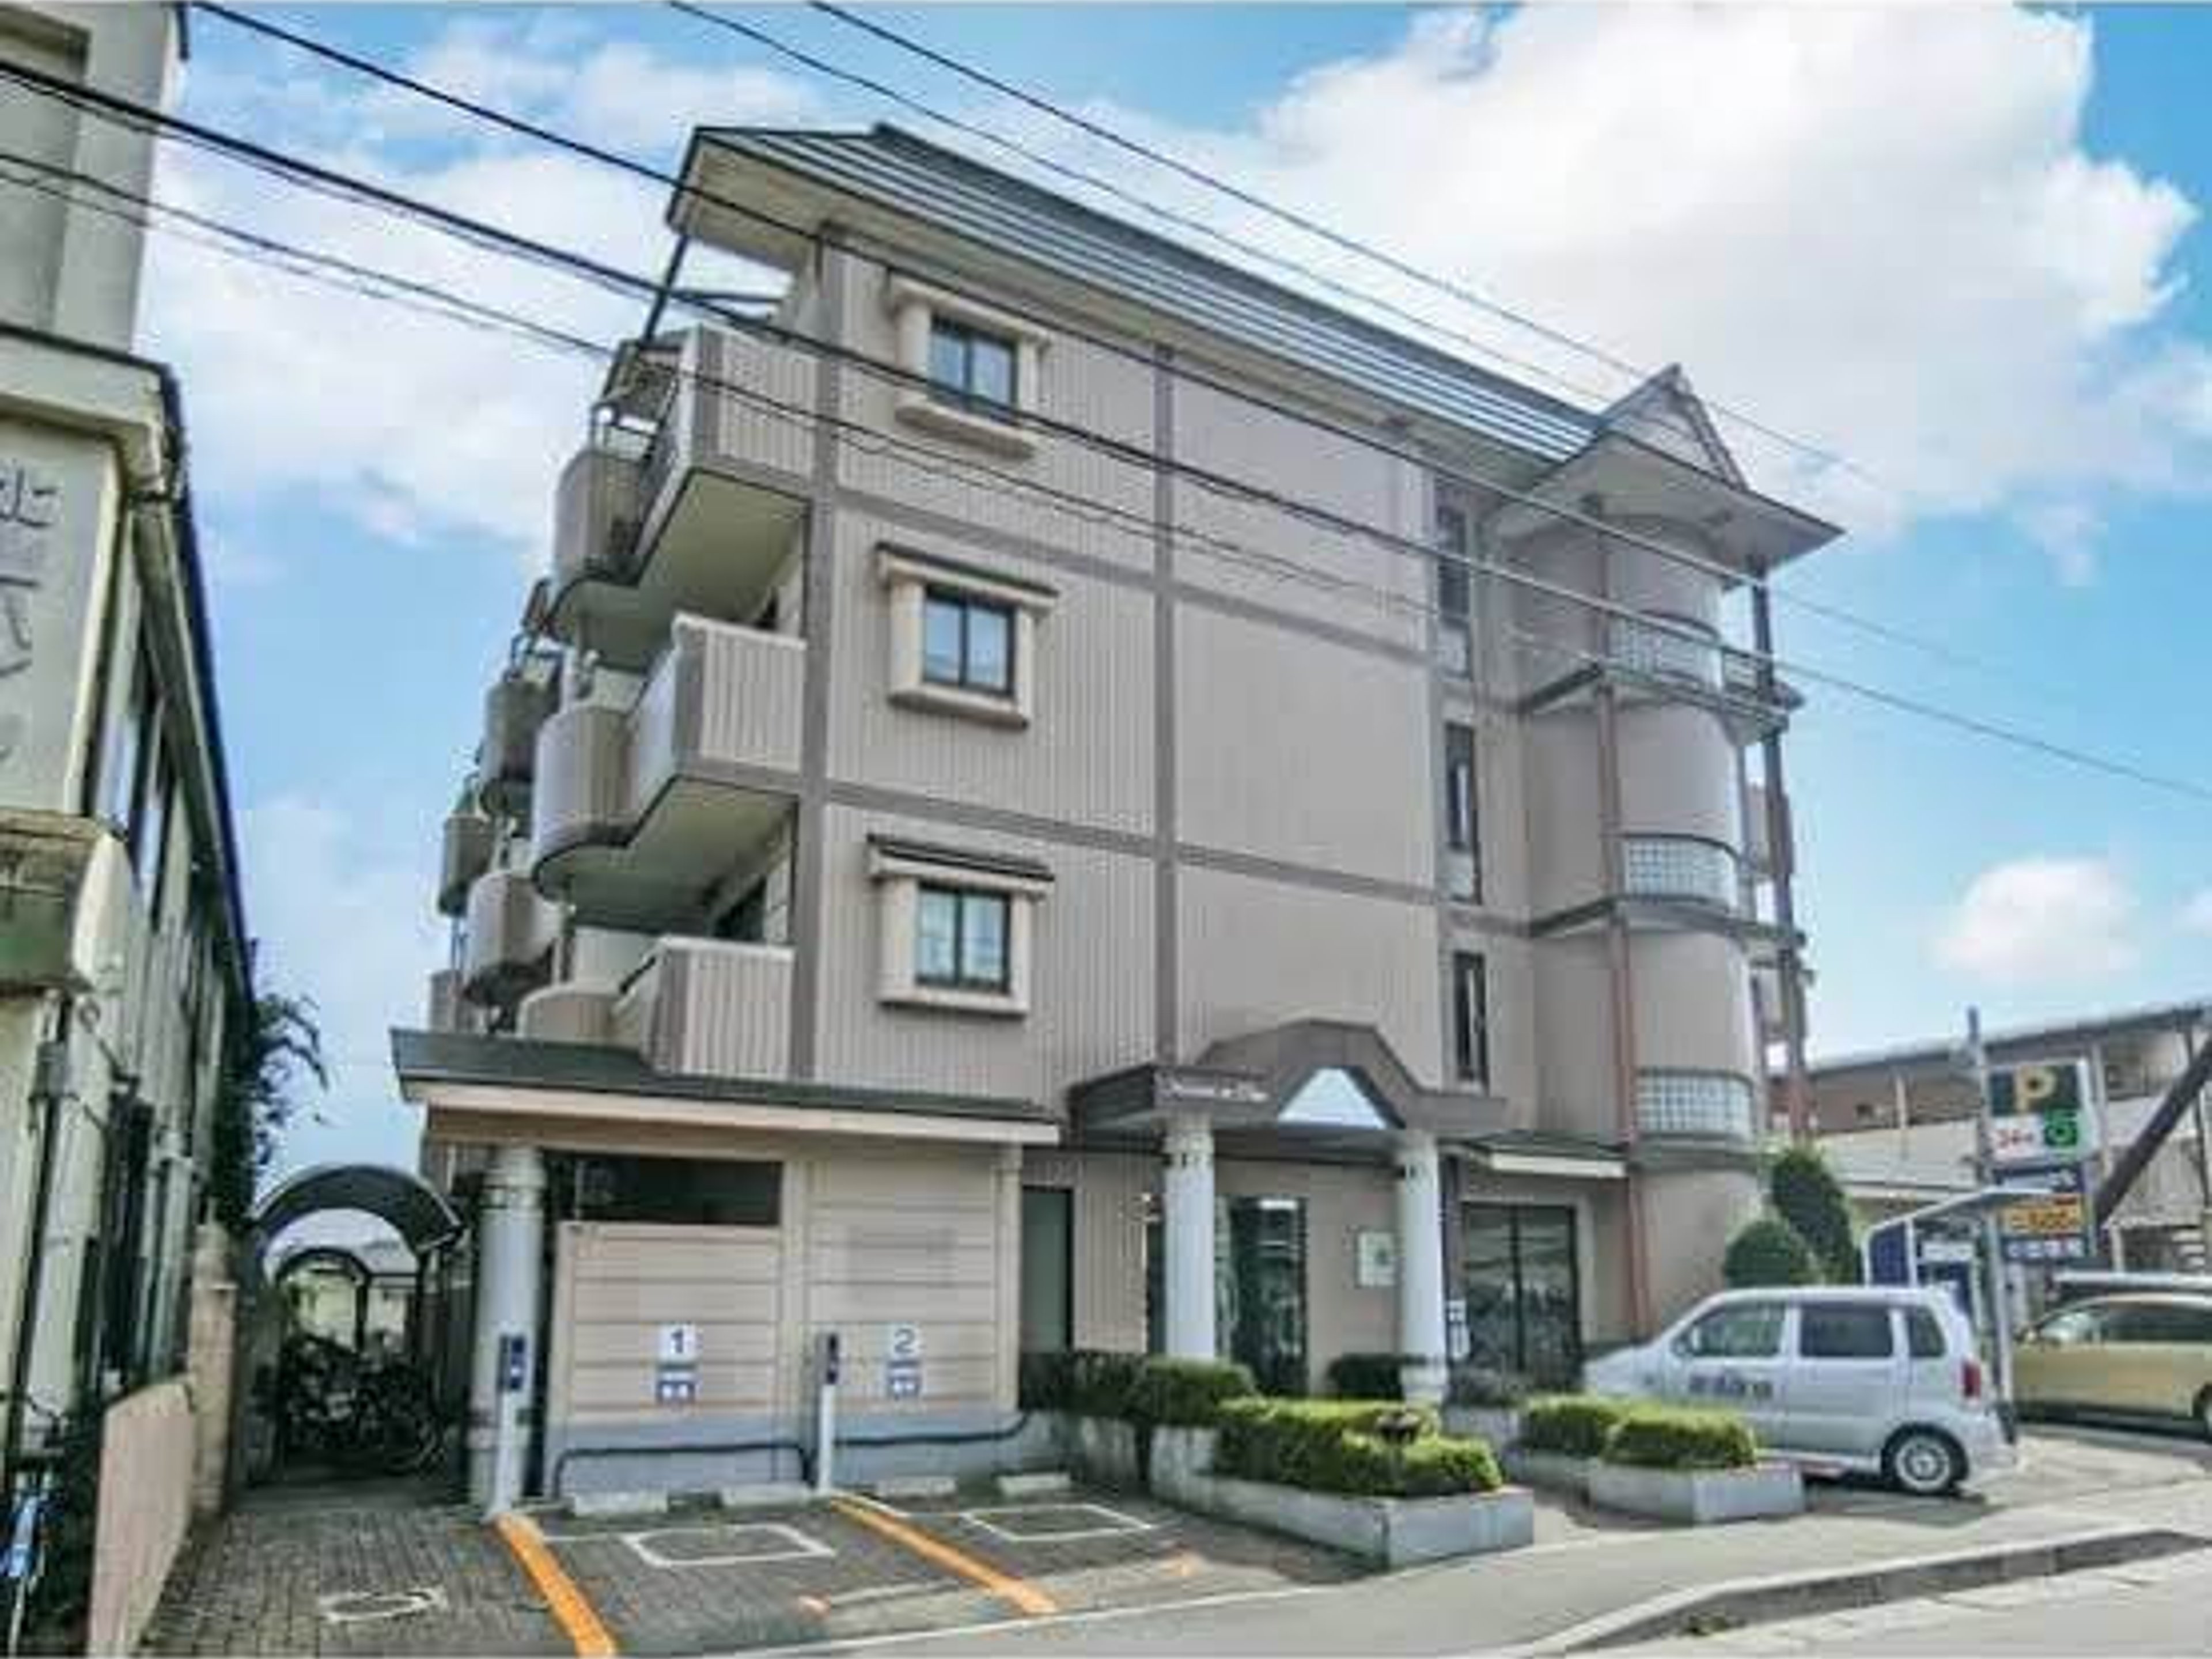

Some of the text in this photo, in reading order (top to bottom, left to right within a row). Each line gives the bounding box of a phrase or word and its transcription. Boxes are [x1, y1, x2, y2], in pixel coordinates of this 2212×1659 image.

[2016, 1065, 2057, 1113] P
[671, 1328, 684, 1353] 1
[894, 1328, 915, 1353] 2
